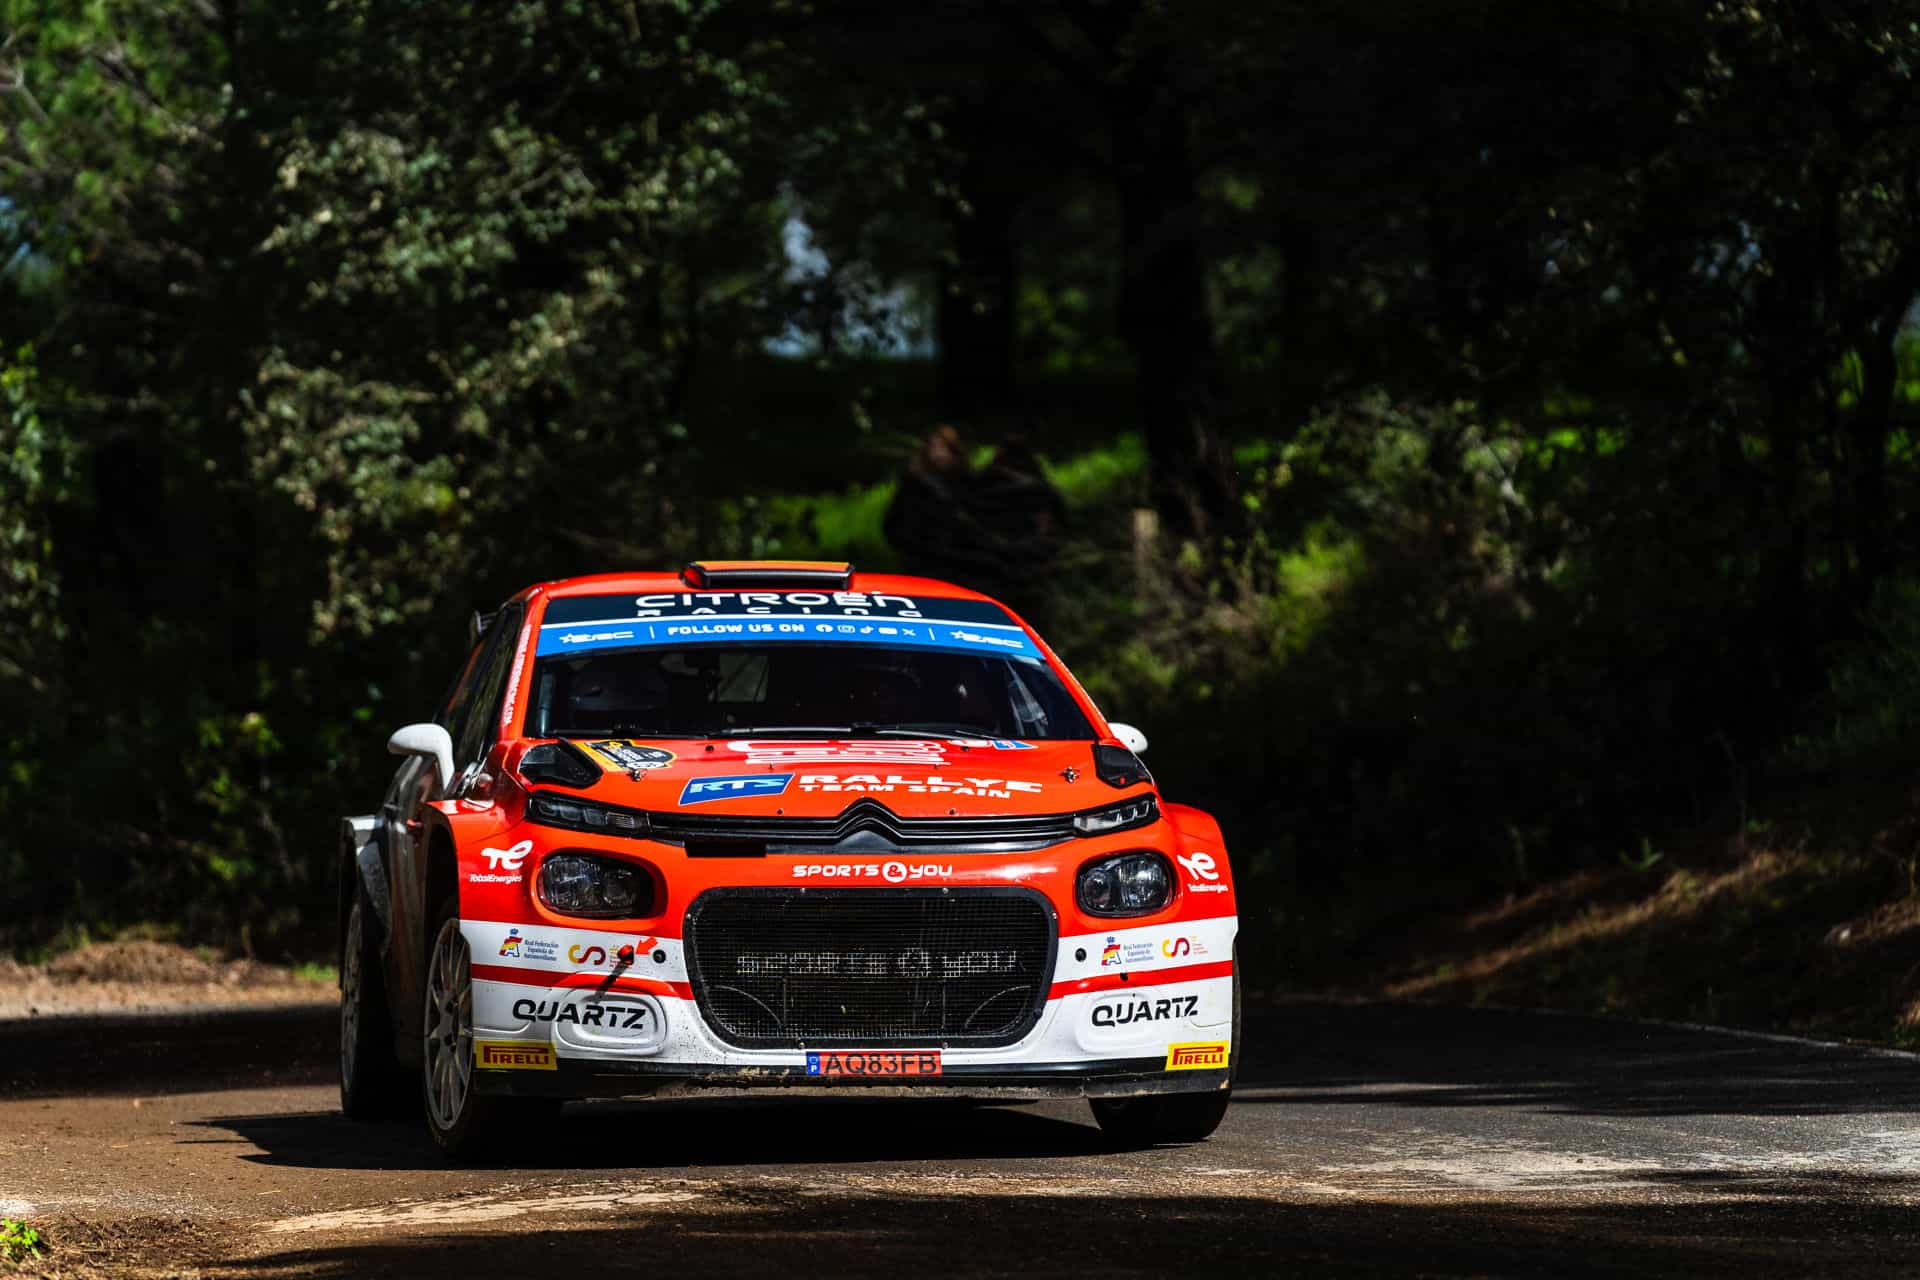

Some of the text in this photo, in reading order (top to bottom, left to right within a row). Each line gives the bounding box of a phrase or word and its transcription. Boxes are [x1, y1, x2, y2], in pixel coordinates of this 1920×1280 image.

[668, 623, 806, 636] FOLLOW US ON
[690, 775, 786, 795] RTS
[799, 774, 1043, 793] RALLYE
[800, 783, 1011, 798] TEAM SPAIN
[793, 863, 880, 878] SPORTS
[909, 864, 953, 878] YOU
[512, 999, 647, 1029] QUARTZ
[1091, 995, 1199, 1027] QUARTZ
[483, 1044, 550, 1065] PIRELLI
[825, 1052, 937, 1074] AQ83FB
[1172, 1045, 1225, 1066] PIRELLI
